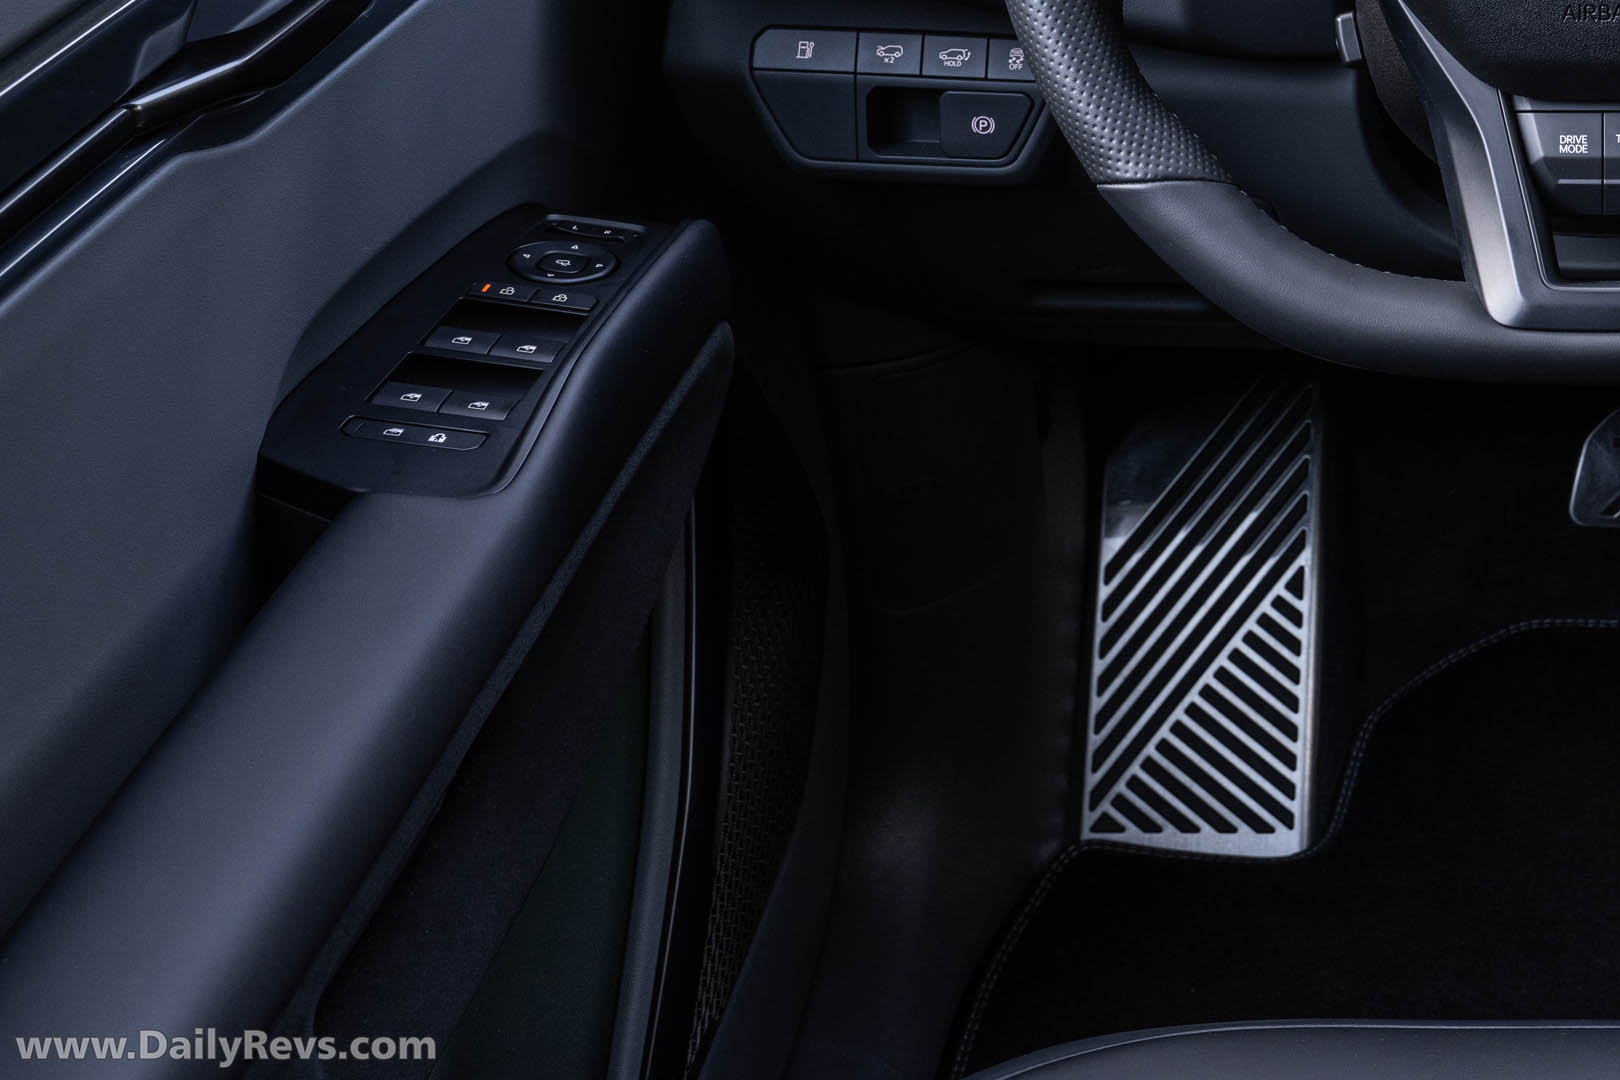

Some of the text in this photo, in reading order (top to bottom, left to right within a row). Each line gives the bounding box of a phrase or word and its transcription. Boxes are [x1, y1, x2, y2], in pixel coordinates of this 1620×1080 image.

[1007, 62, 1024, 71] OFF
[1559, 133, 1589, 145] DRIVE
[1559, 144, 1589, 155] MODE
